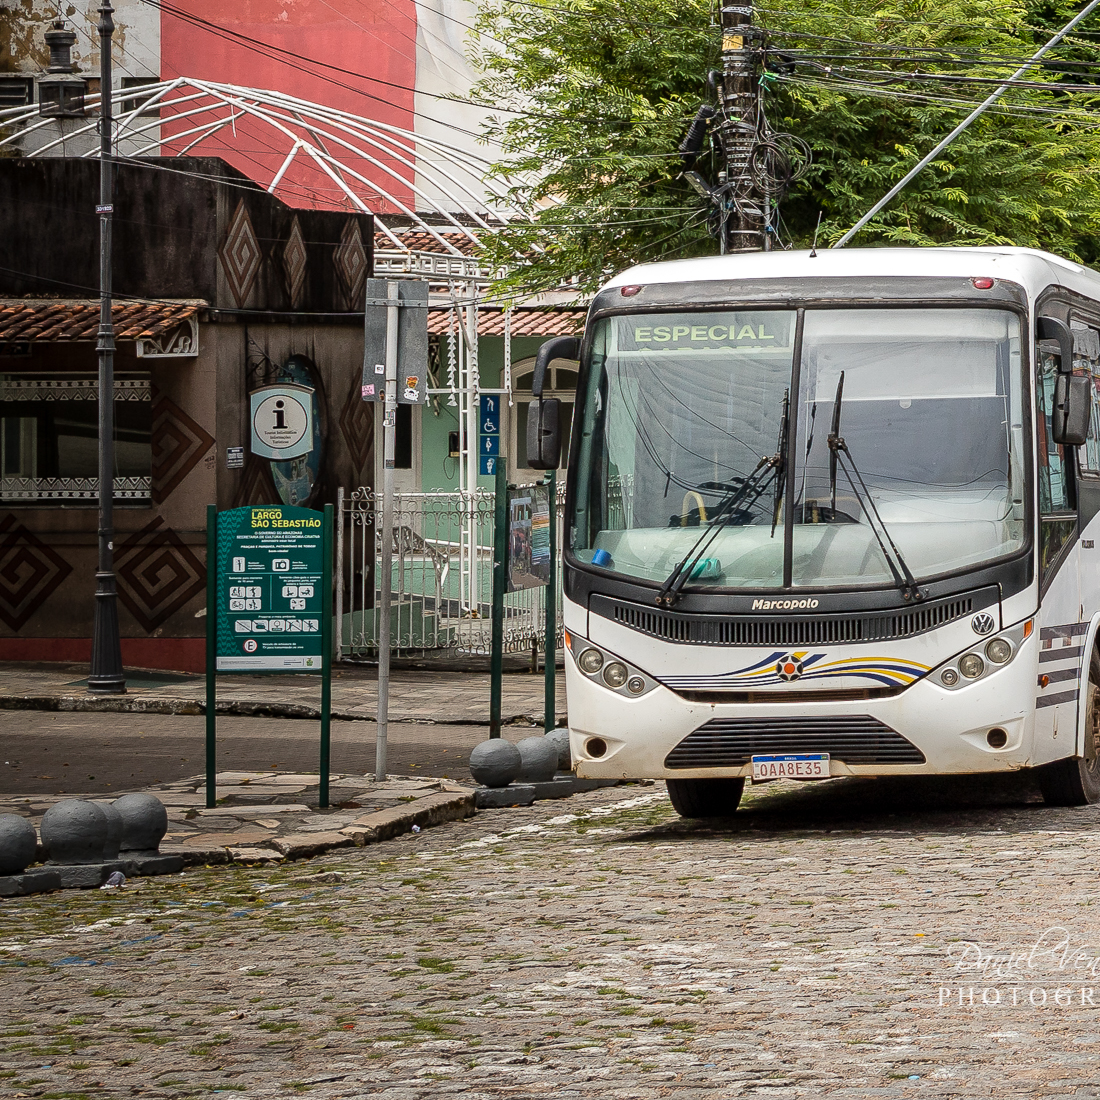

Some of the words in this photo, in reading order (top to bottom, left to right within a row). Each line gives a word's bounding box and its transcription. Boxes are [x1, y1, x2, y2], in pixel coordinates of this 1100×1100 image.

[635, 324, 775, 342] ESPECIAL
[251, 511, 282, 520] LARGO
[251, 518, 270, 528] SÃO
[271, 517, 321, 528] SEBASTIÃO
[751, 598, 819, 611] Marcopolo
